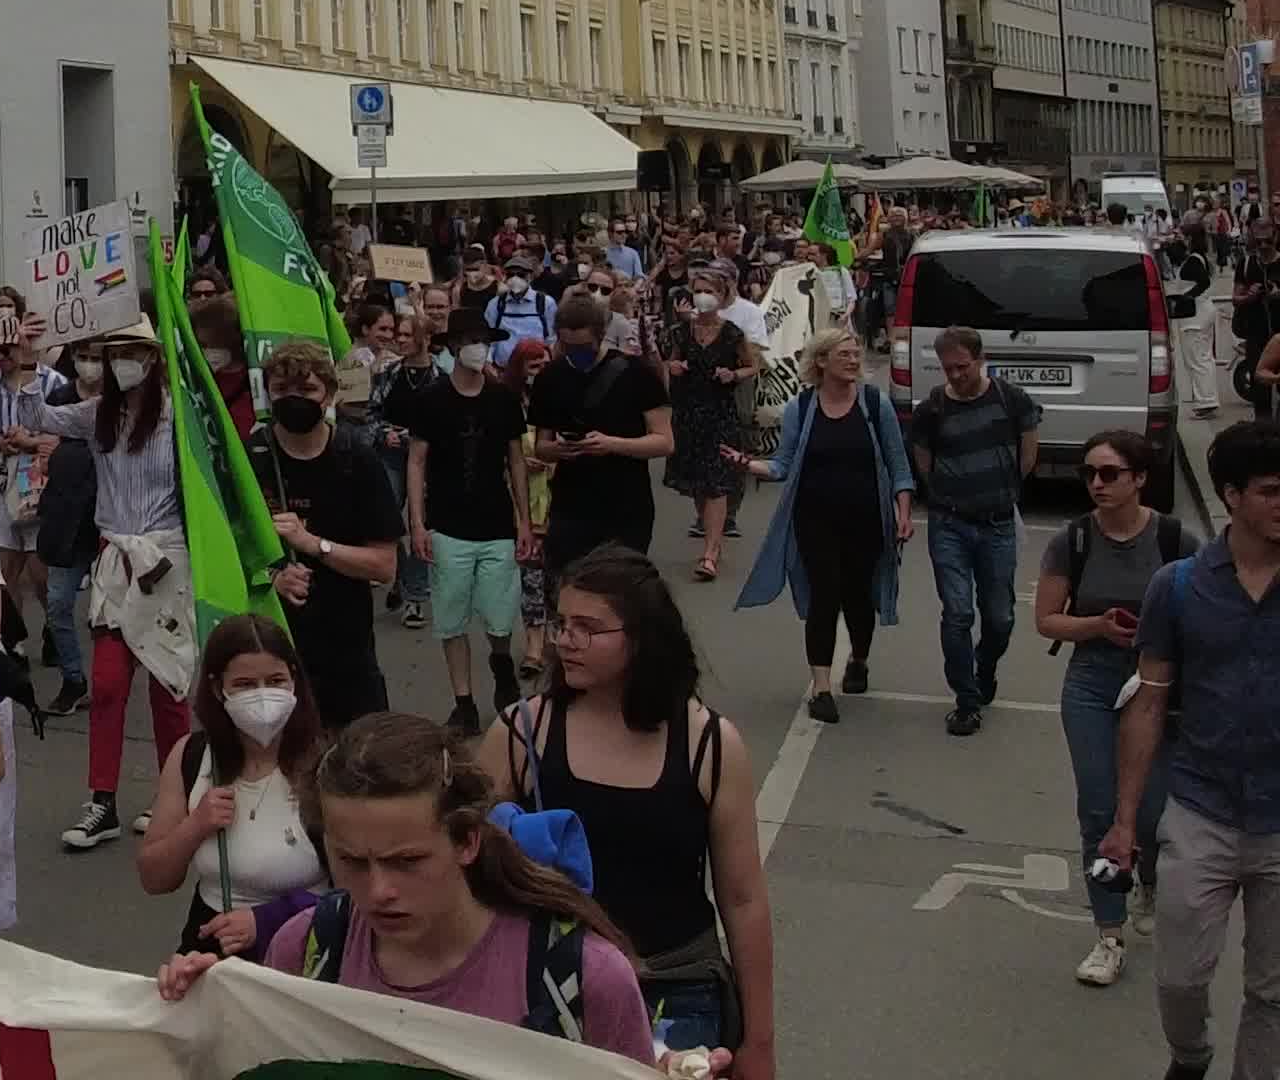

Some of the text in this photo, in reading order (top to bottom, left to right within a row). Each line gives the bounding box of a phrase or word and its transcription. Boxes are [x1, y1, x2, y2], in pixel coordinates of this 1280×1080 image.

[42, 212, 100, 254] make
[33, 233, 121, 283] LOVE
[56, 267, 80, 302] not
